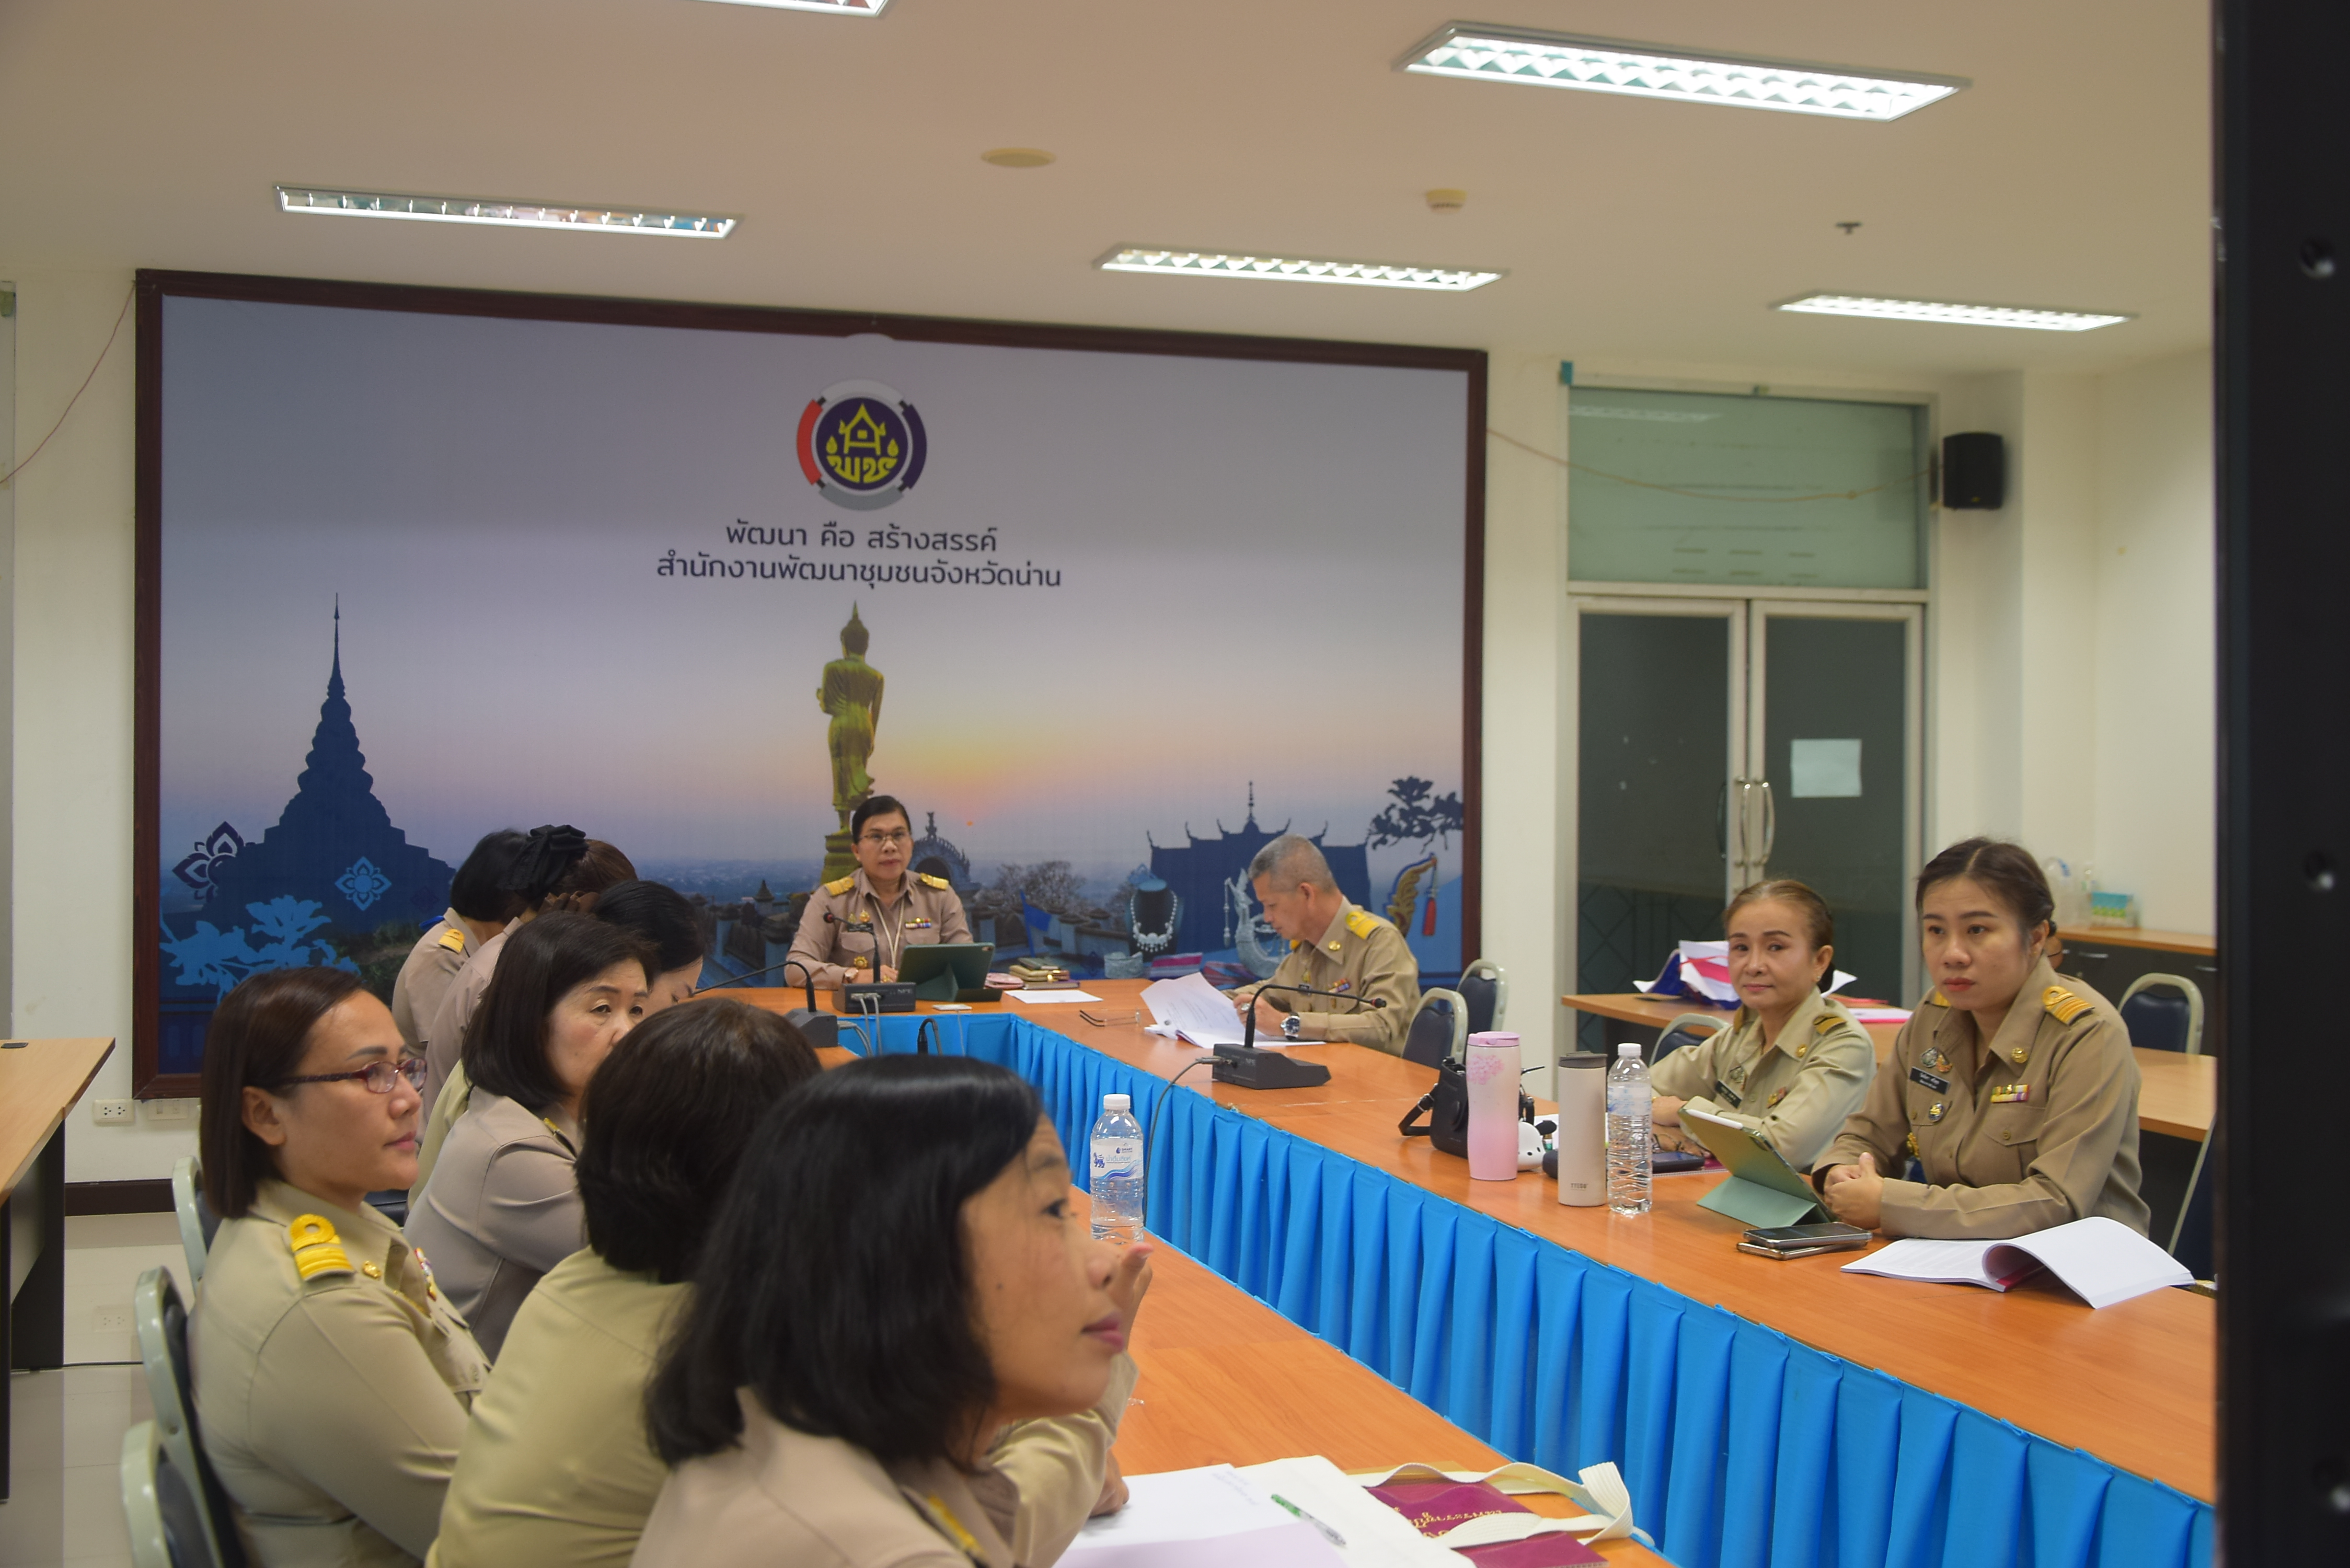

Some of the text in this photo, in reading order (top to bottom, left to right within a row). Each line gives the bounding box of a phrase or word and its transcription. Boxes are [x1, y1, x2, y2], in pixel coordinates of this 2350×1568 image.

[726, 518, 997, 552] พัฒนา คือ สร้างสรรค์
[656, 549, 1061, 590] สำนักงานพัฒนาชุมชนจังหวัดน่าน
